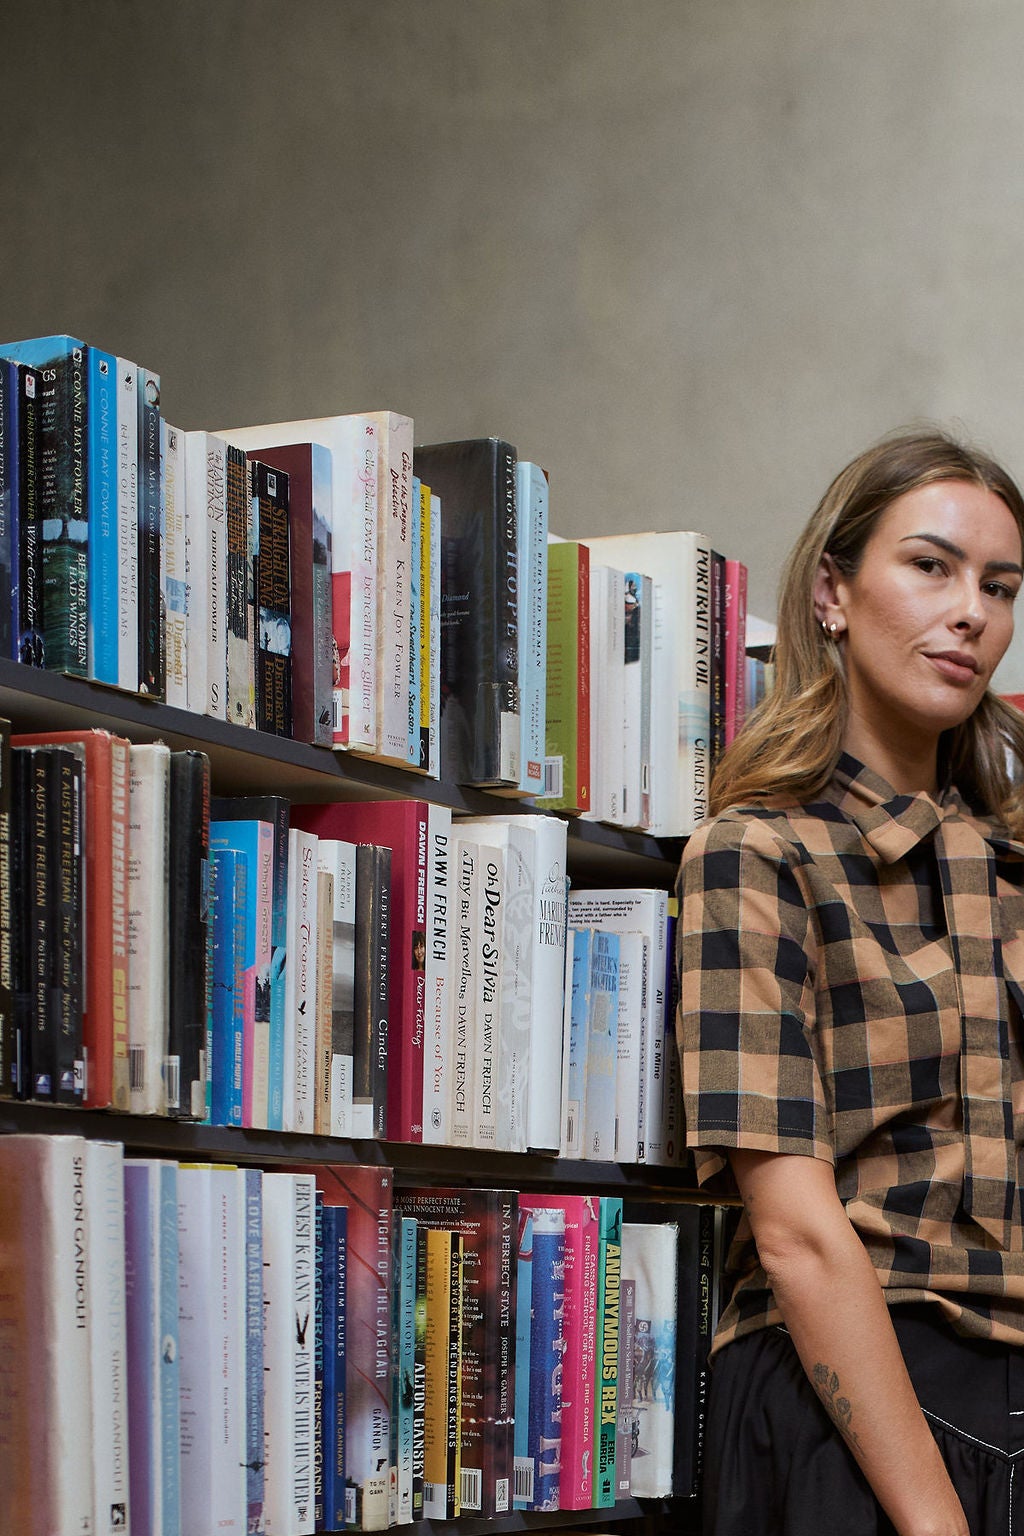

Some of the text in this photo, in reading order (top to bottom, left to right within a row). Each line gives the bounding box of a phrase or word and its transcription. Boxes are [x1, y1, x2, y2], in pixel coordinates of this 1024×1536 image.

[73, 371, 82, 514] CONNIE MAY FOWLER
[100, 388, 109, 537] CONNIE MAY FOWLER
[390, 469, 400, 518] Detective
[395, 559, 405, 606] KAREN
[506, 455, 518, 638] DIAMOND HOPE
[69, 566, 77, 647] HAD WINGS
[78, 553, 86, 666] BEFORE WOMEN
[393, 613, 404, 638] JOY
[696, 548, 709, 688] PORTRAIT IN OIL
[174, 619, 184, 687] DEBORAH
[394, 643, 403, 698] FOWLER
[694, 738, 708, 821] CHARLES FOX
[459, 858, 473, 898] Tiny
[461, 899, 469, 920] Bit
[432, 834, 447, 1093] DAWN FRENCH Because of You
[458, 925, 472, 1000] Marvellous
[482, 863, 500, 1114] Oh Dear Silvia DAWN FRENCH
[655, 989, 663, 1004] All
[457, 1005, 467, 1049] DAWN
[654, 1039, 661, 1050] Is
[456, 1051, 466, 1112] FRENCH
[375, 1209, 388, 1379] NIGHT OF THE JAGUAR
[500, 1203, 510, 1414] IN A PERFECT STATE JOSEPH R. GARBER
[295, 1183, 311, 1504] ERNEST K GANN FATE IS THE HUNTER
[336, 1238, 346, 1477] SERAPHIM BLUES STEVEN GANNAWAY
[402, 1228, 414, 1474] DISTANT MEMORY GANSKY
[449, 1252, 459, 1448] GANSWORTH MENDING SKINS
[601, 1243, 621, 1465] ANONYMOUS REX ERIC
[413, 1363, 426, 1413] ALTON
[412, 1417, 425, 1480] GANSKY
[599, 1433, 607, 1474] GARCIA
